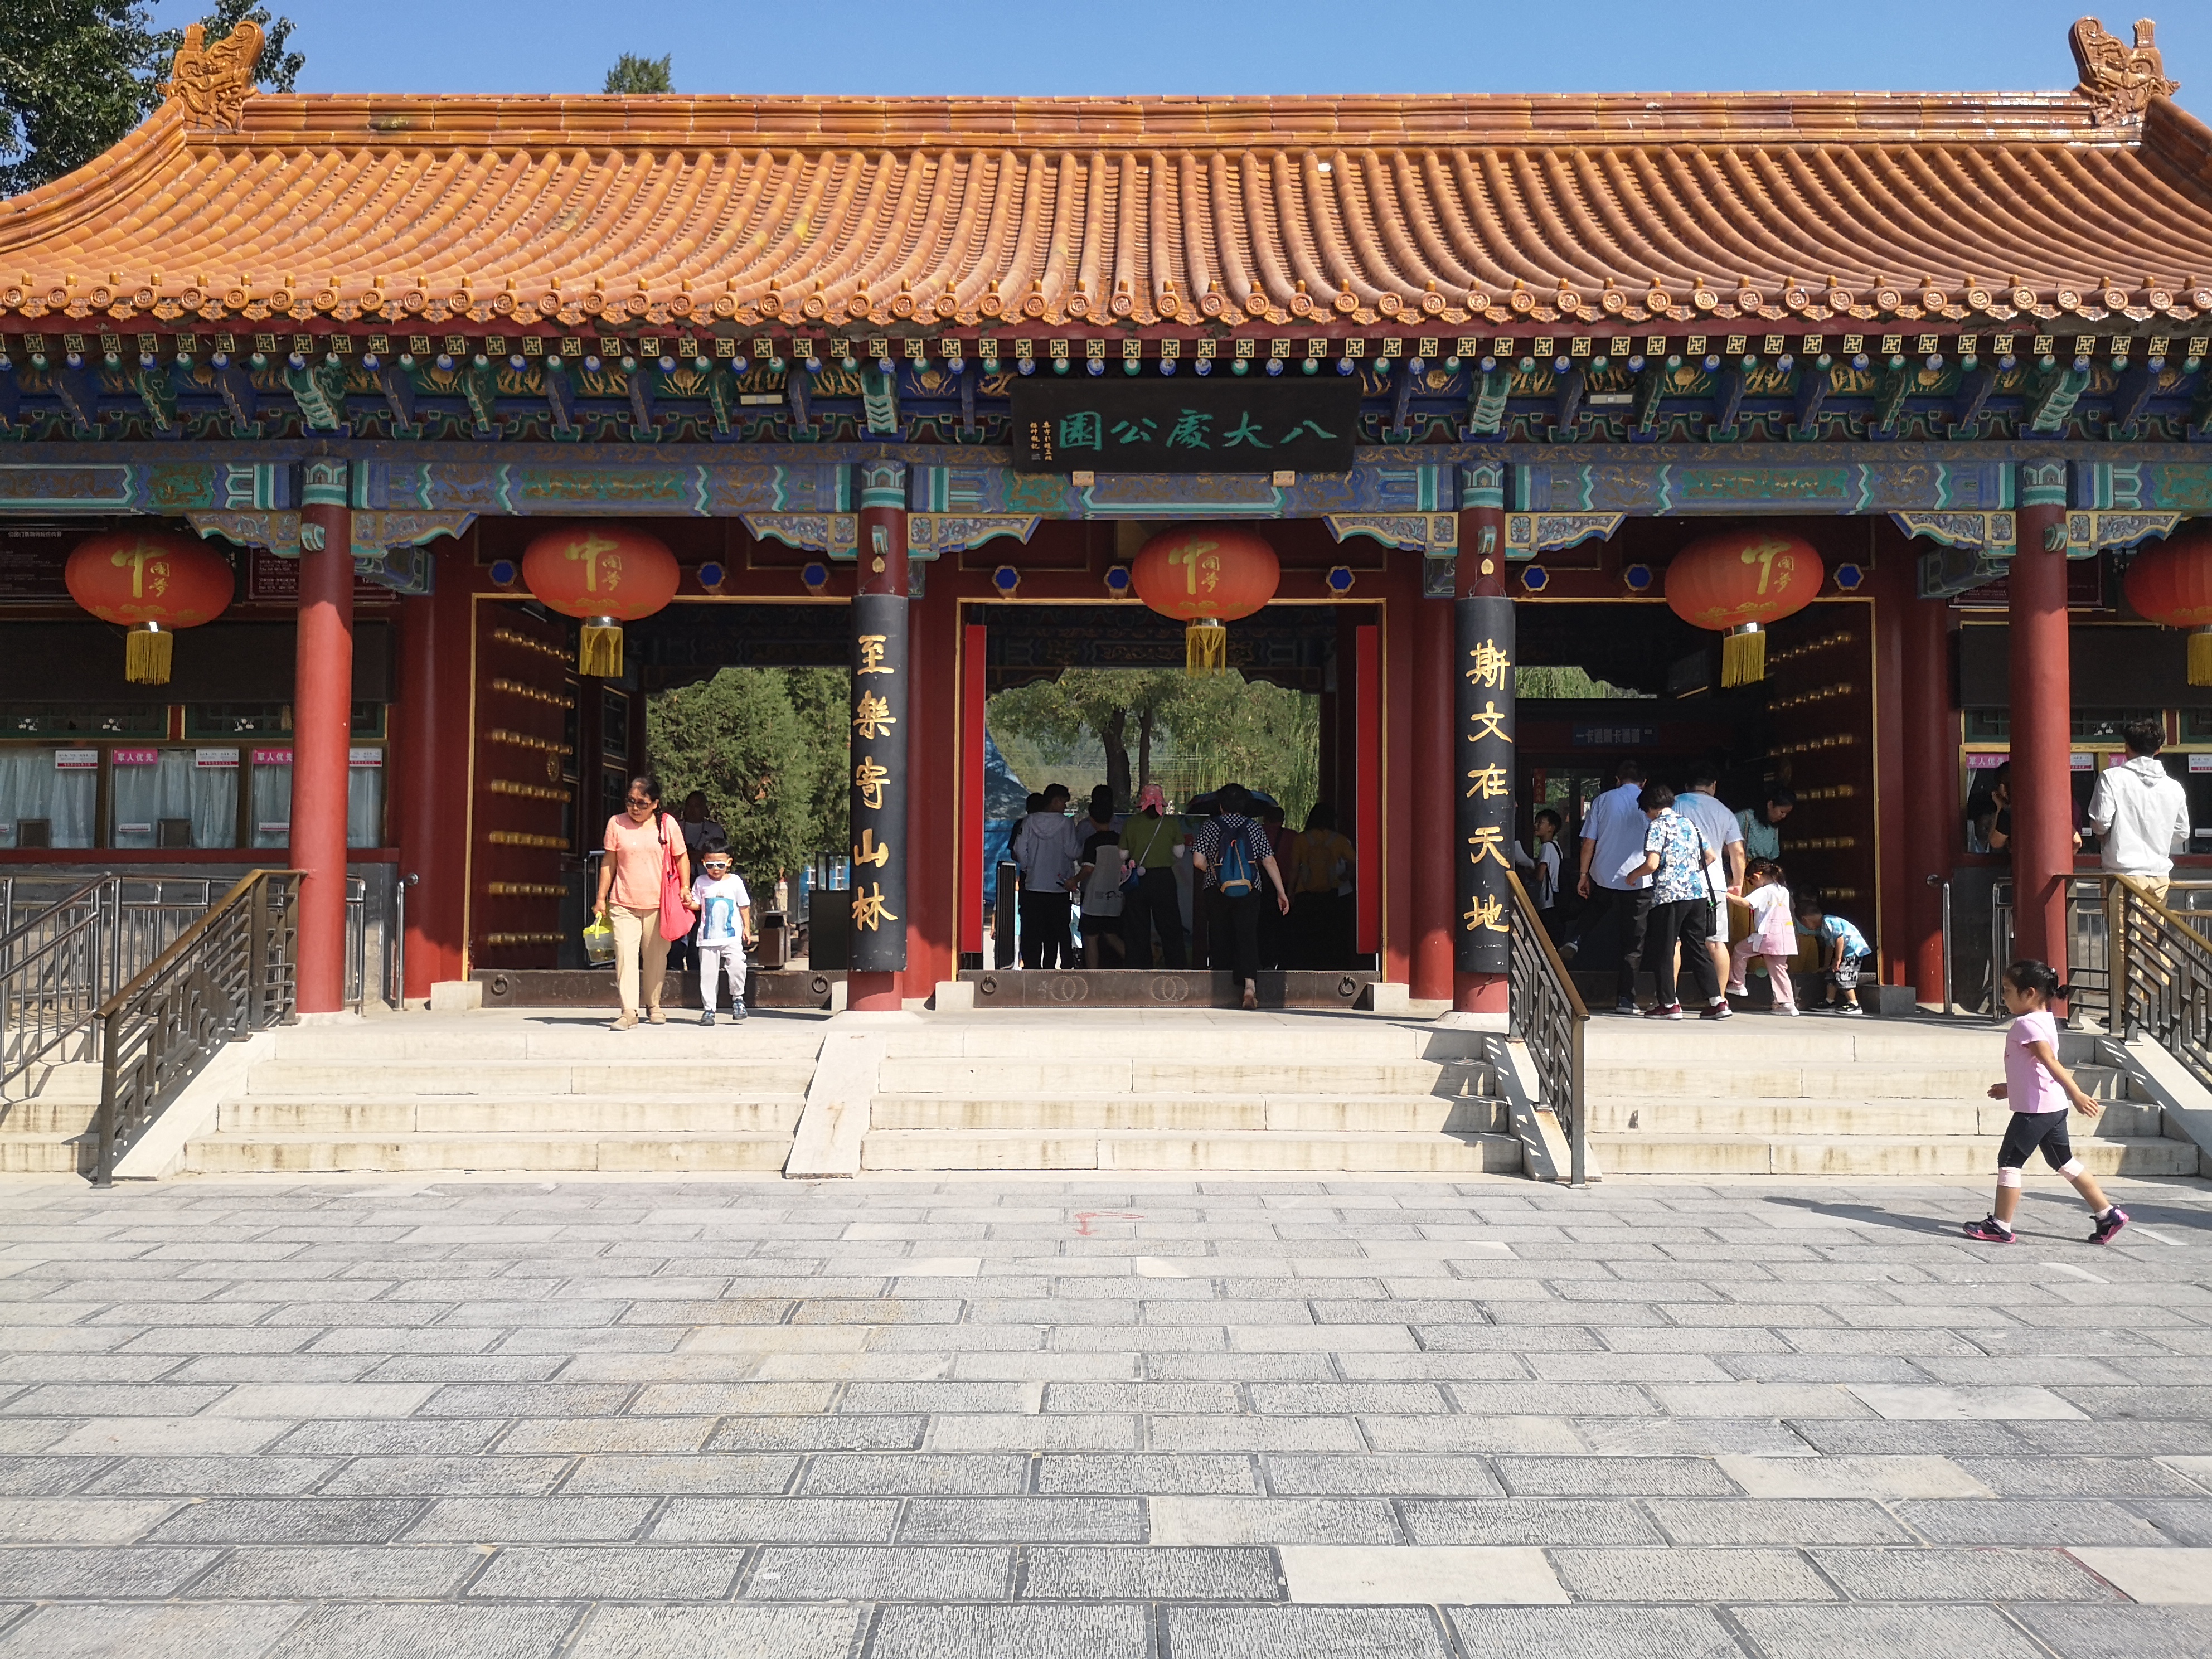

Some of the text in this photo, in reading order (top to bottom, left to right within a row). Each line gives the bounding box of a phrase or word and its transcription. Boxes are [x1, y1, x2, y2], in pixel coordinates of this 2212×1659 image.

[1463, 639, 1512, 933] 斯文在天地
